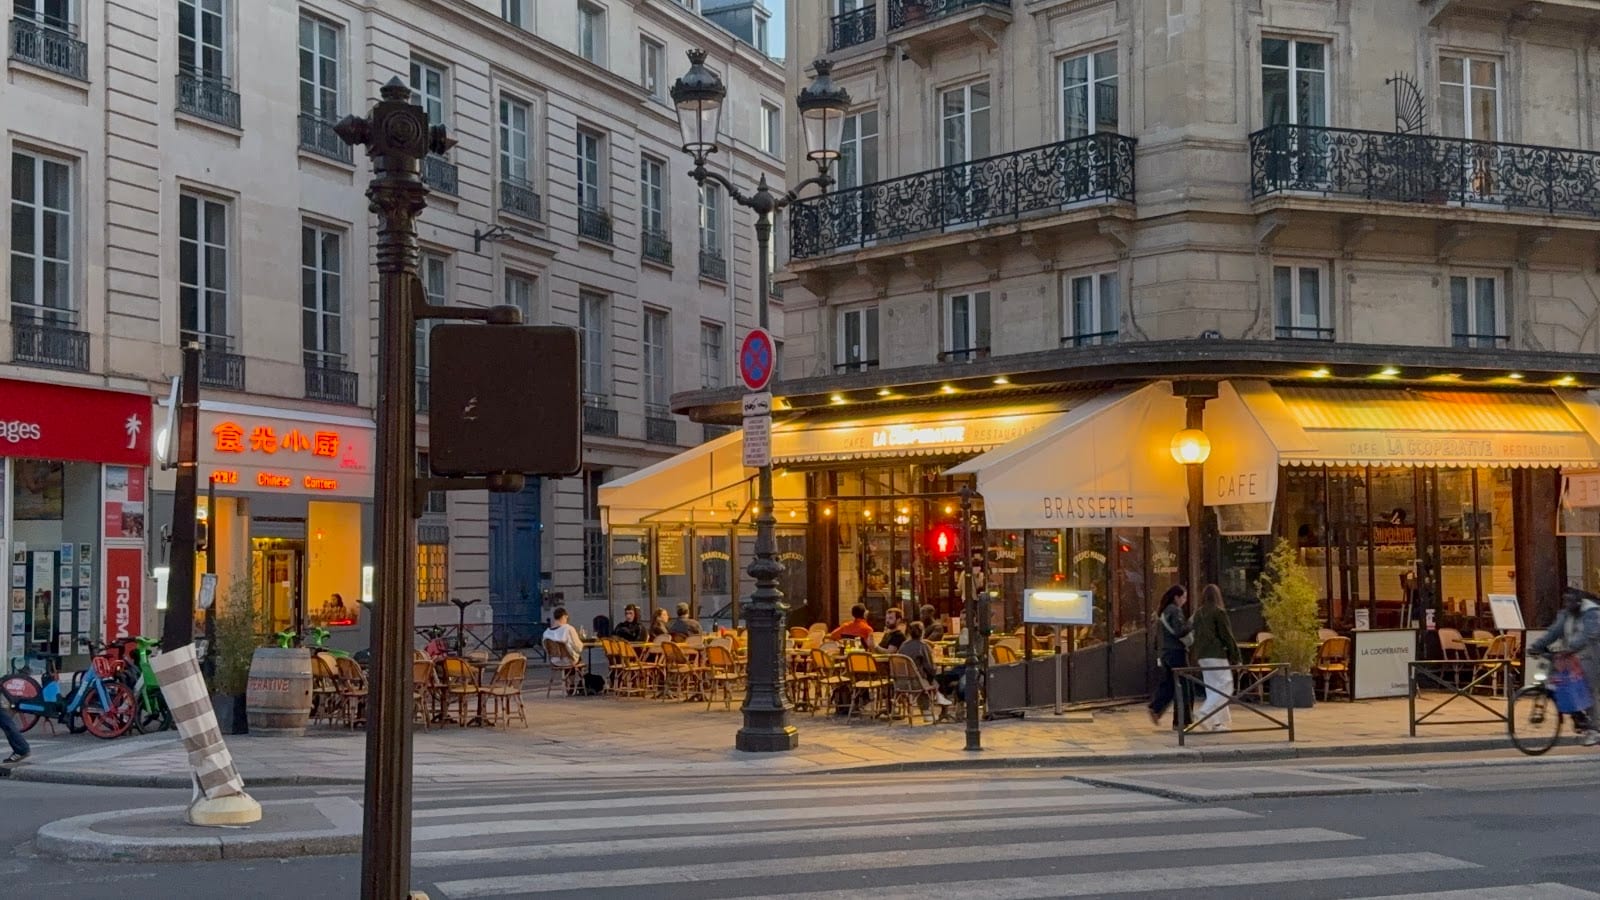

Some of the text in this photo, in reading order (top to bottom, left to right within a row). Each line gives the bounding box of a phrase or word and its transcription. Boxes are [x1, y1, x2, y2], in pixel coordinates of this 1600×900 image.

[0, 420, 41, 443] ages
[212, 421, 341, 458] 食光小厨
[872, 431, 887, 447] LA
[1387, 439, 1403, 456] LA
[1503, 444, 1566, 457] RESTAURANT
[257, 471, 292, 488] Chinese
[304, 475, 337, 490] Canteen
[1217, 473, 1257, 498] CAFE
[1043, 496, 1134, 519] BRASSERIE
[115, 575, 130, 639] FRAM
[1361, 645, 1409, 656] LA COOPÉRATIVE
